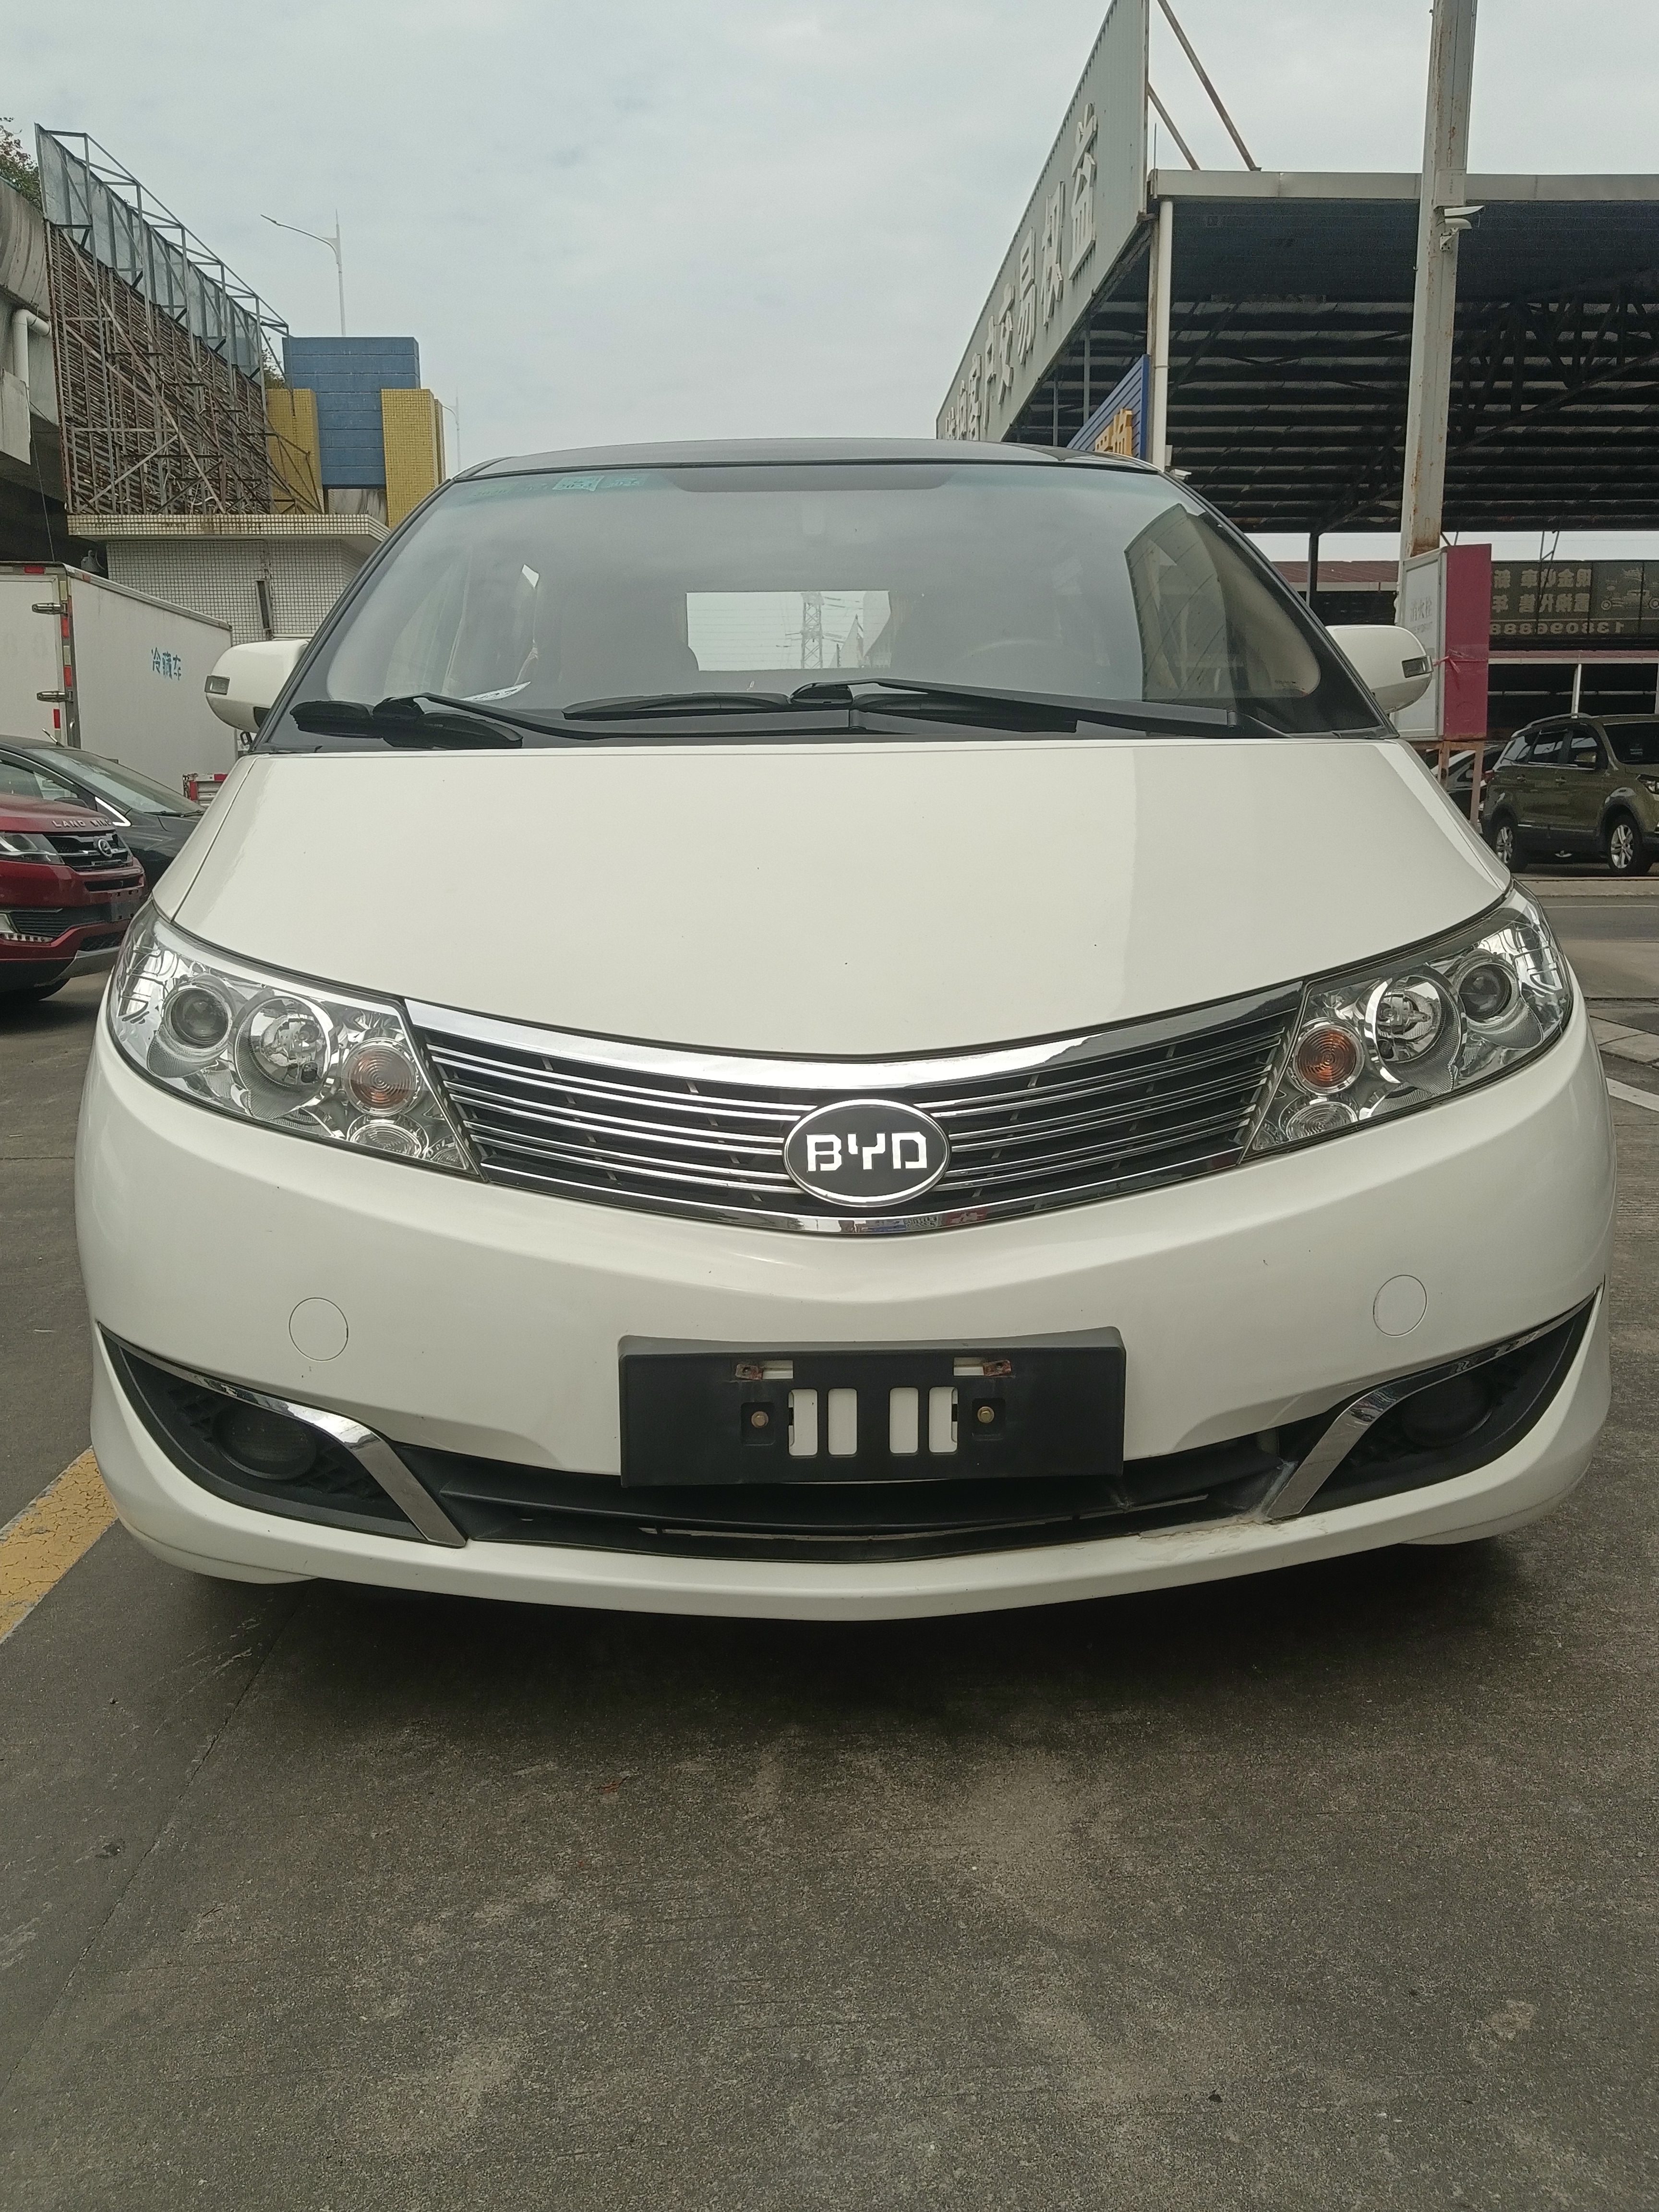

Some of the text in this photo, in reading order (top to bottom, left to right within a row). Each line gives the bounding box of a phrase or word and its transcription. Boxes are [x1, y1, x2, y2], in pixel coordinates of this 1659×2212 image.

[151, 647, 181, 681] 冷藏车
[51, 819, 86, 828] LAND
[806, 1131, 927, 1172] BYD
